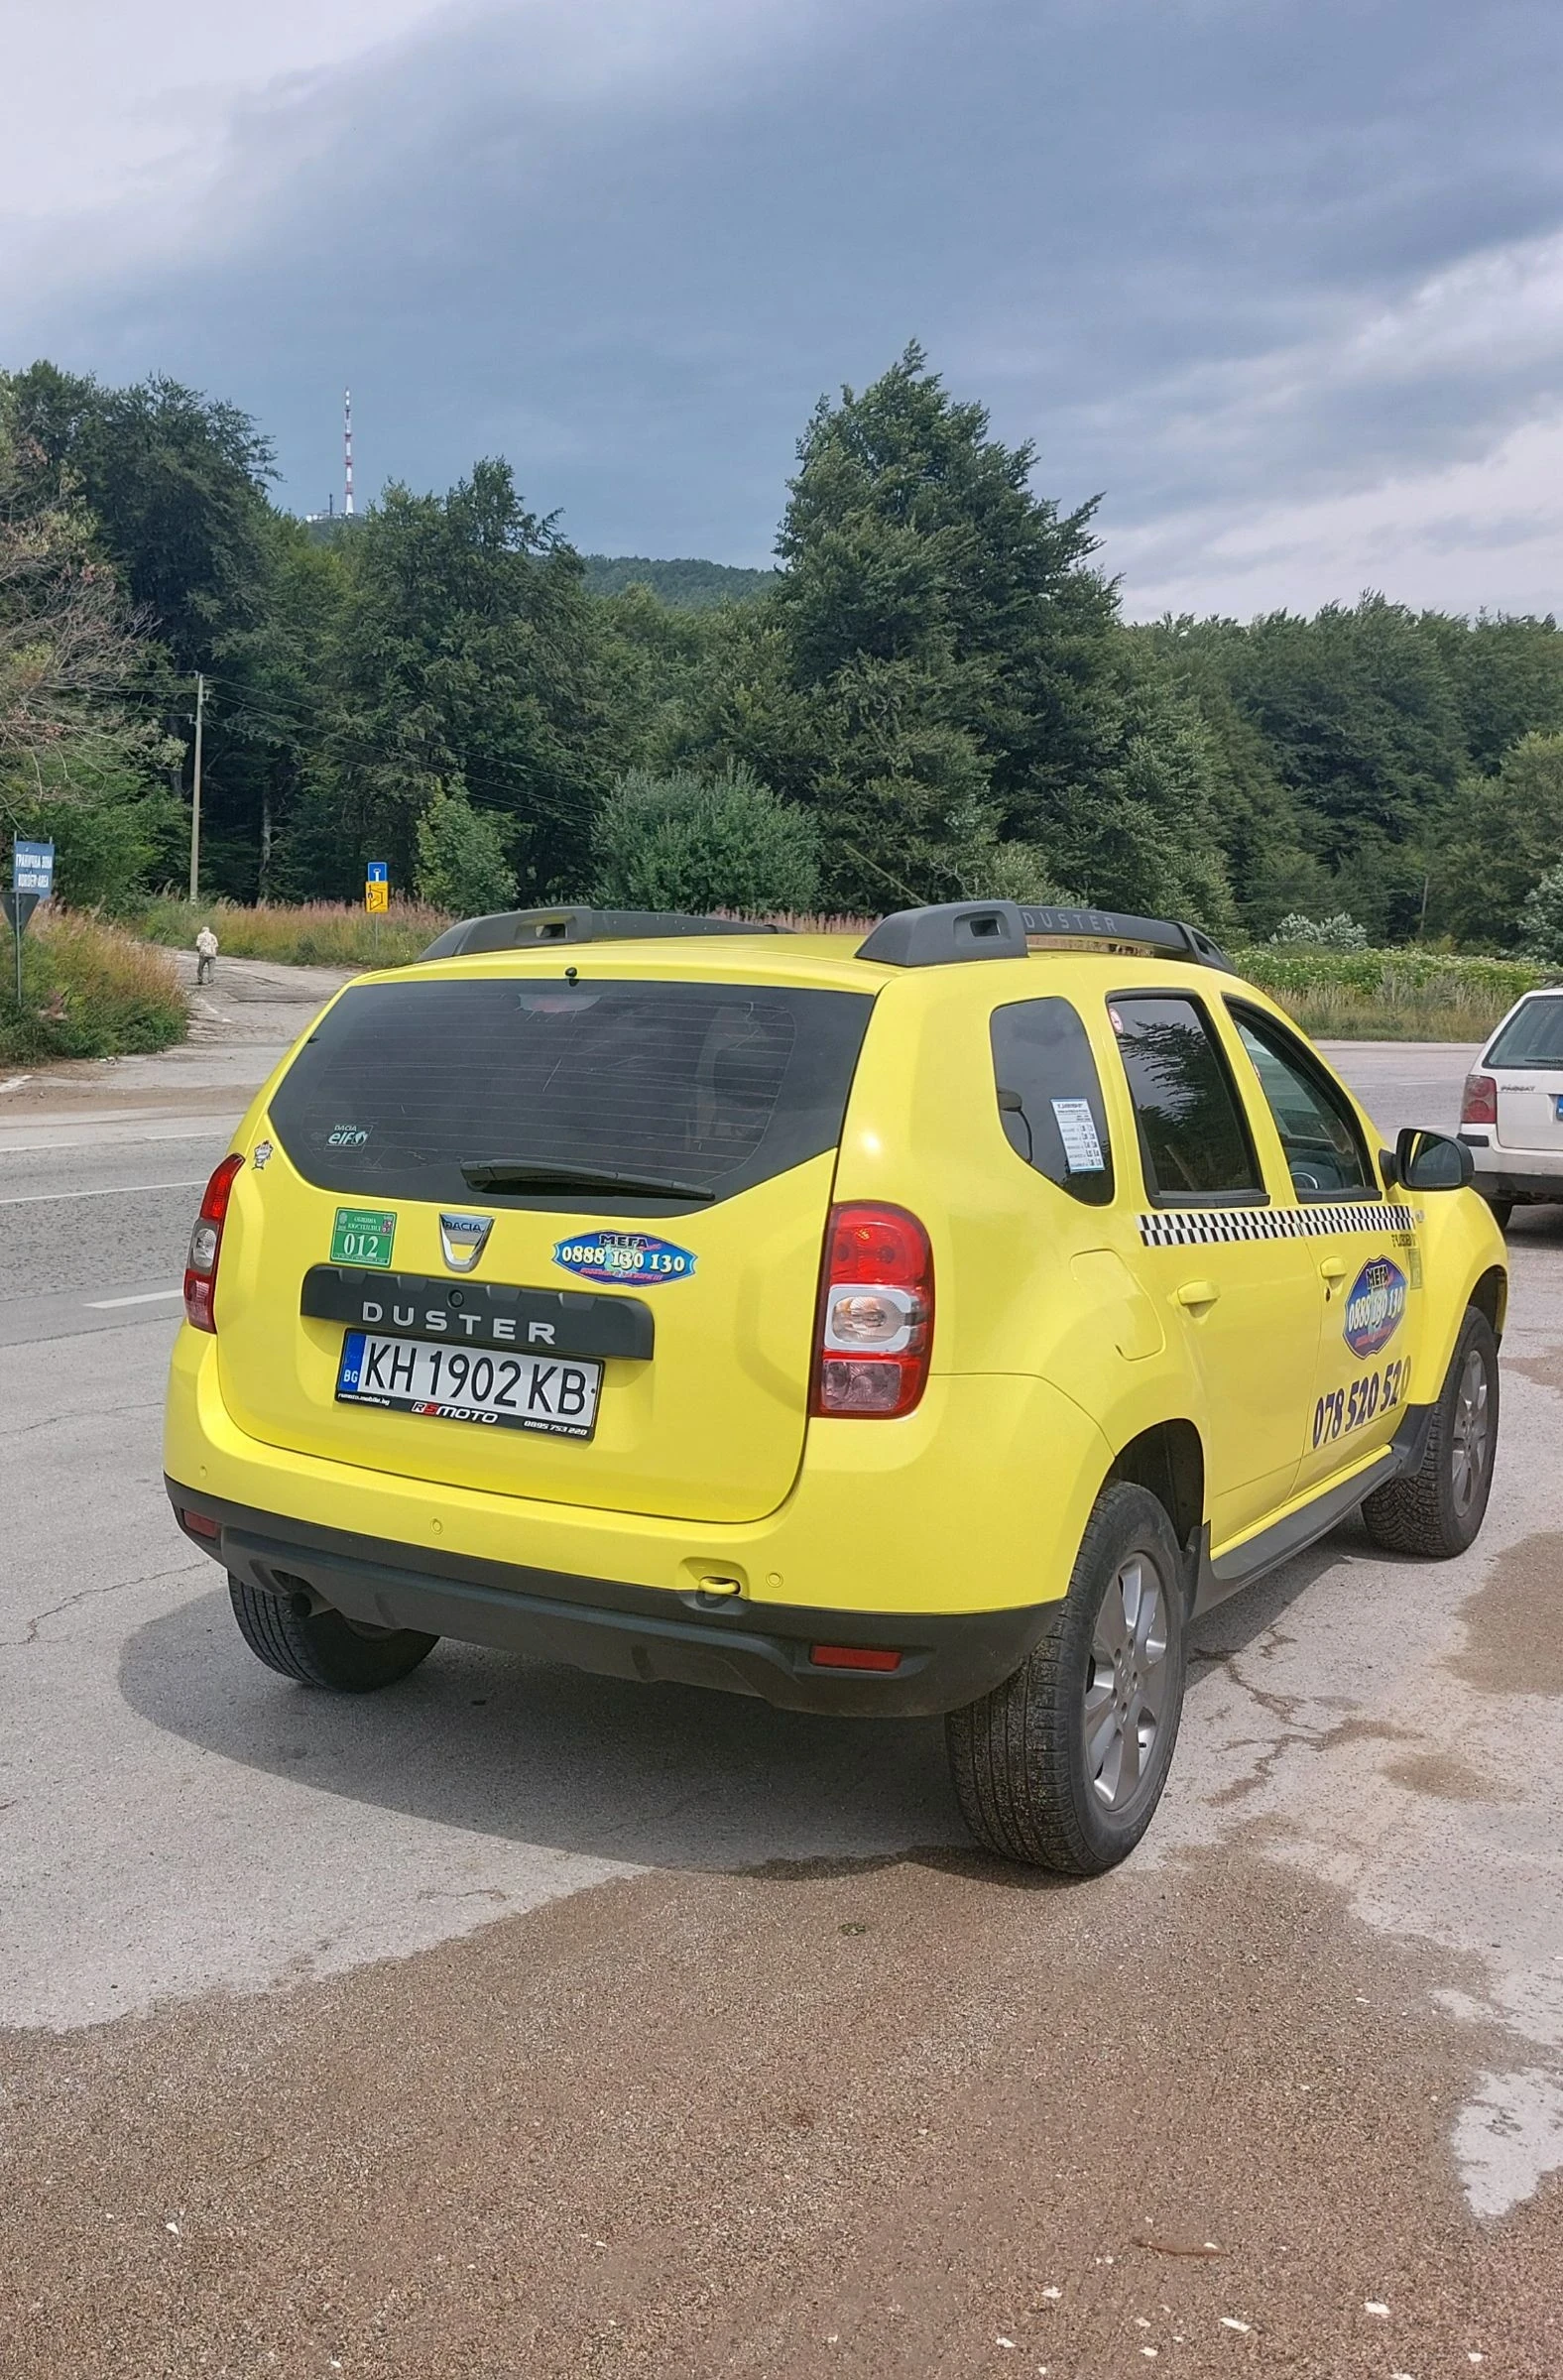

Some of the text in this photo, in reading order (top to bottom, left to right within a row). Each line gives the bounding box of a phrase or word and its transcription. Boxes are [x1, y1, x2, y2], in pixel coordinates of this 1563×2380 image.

[1022, 911, 1118, 932] DUSTER
[327, 1131, 355, 1145] elf
[444, 1221, 482, 1233] DACIA
[343, 1233, 379, 1257] 012
[561, 1246, 685, 1273] 0888 130 130
[1348, 1296, 1371, 1333] 0888
[1388, 1286, 1403, 1319] 130
[361, 1301, 556, 1345] DUSTER
[343, 1368, 358, 1383] BG
[1312, 1355, 1411, 1450] 078 520 520
[524, 1420, 588, 1436] 0895 753 220
